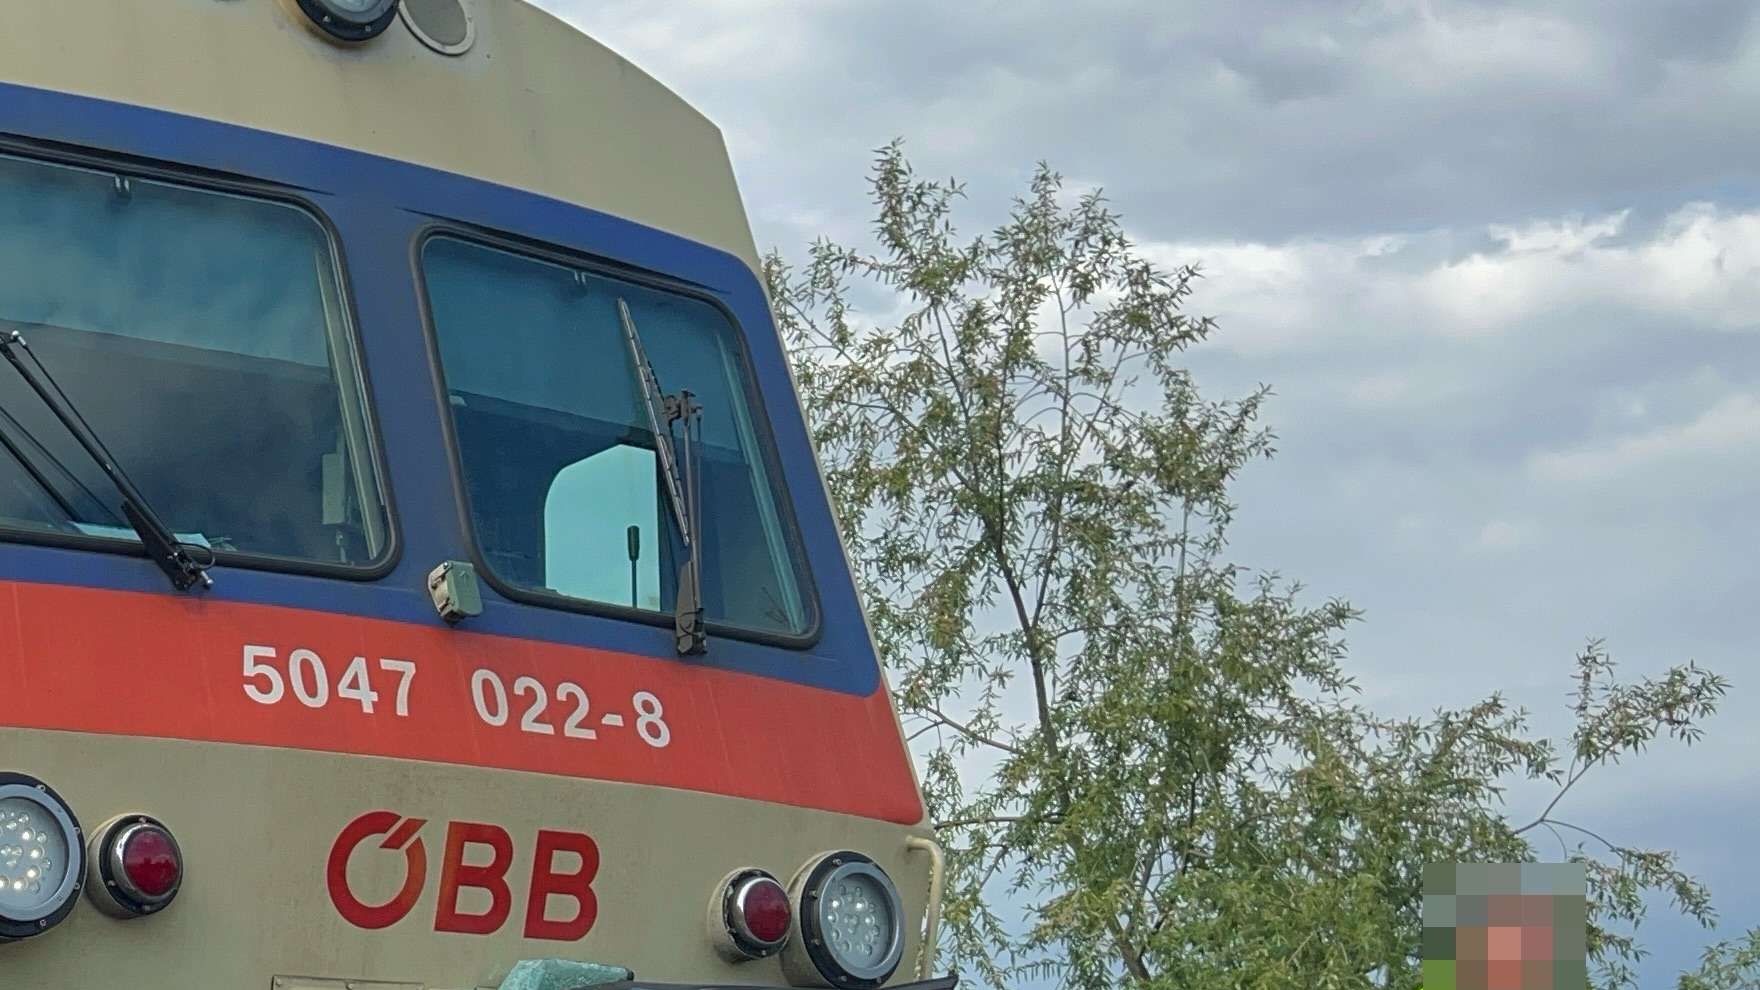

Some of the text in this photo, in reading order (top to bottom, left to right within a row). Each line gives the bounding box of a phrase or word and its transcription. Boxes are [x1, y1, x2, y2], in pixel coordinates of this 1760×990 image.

[242, 645, 671, 748] 5047 022-8
[326, 810, 600, 942] ÖBB
